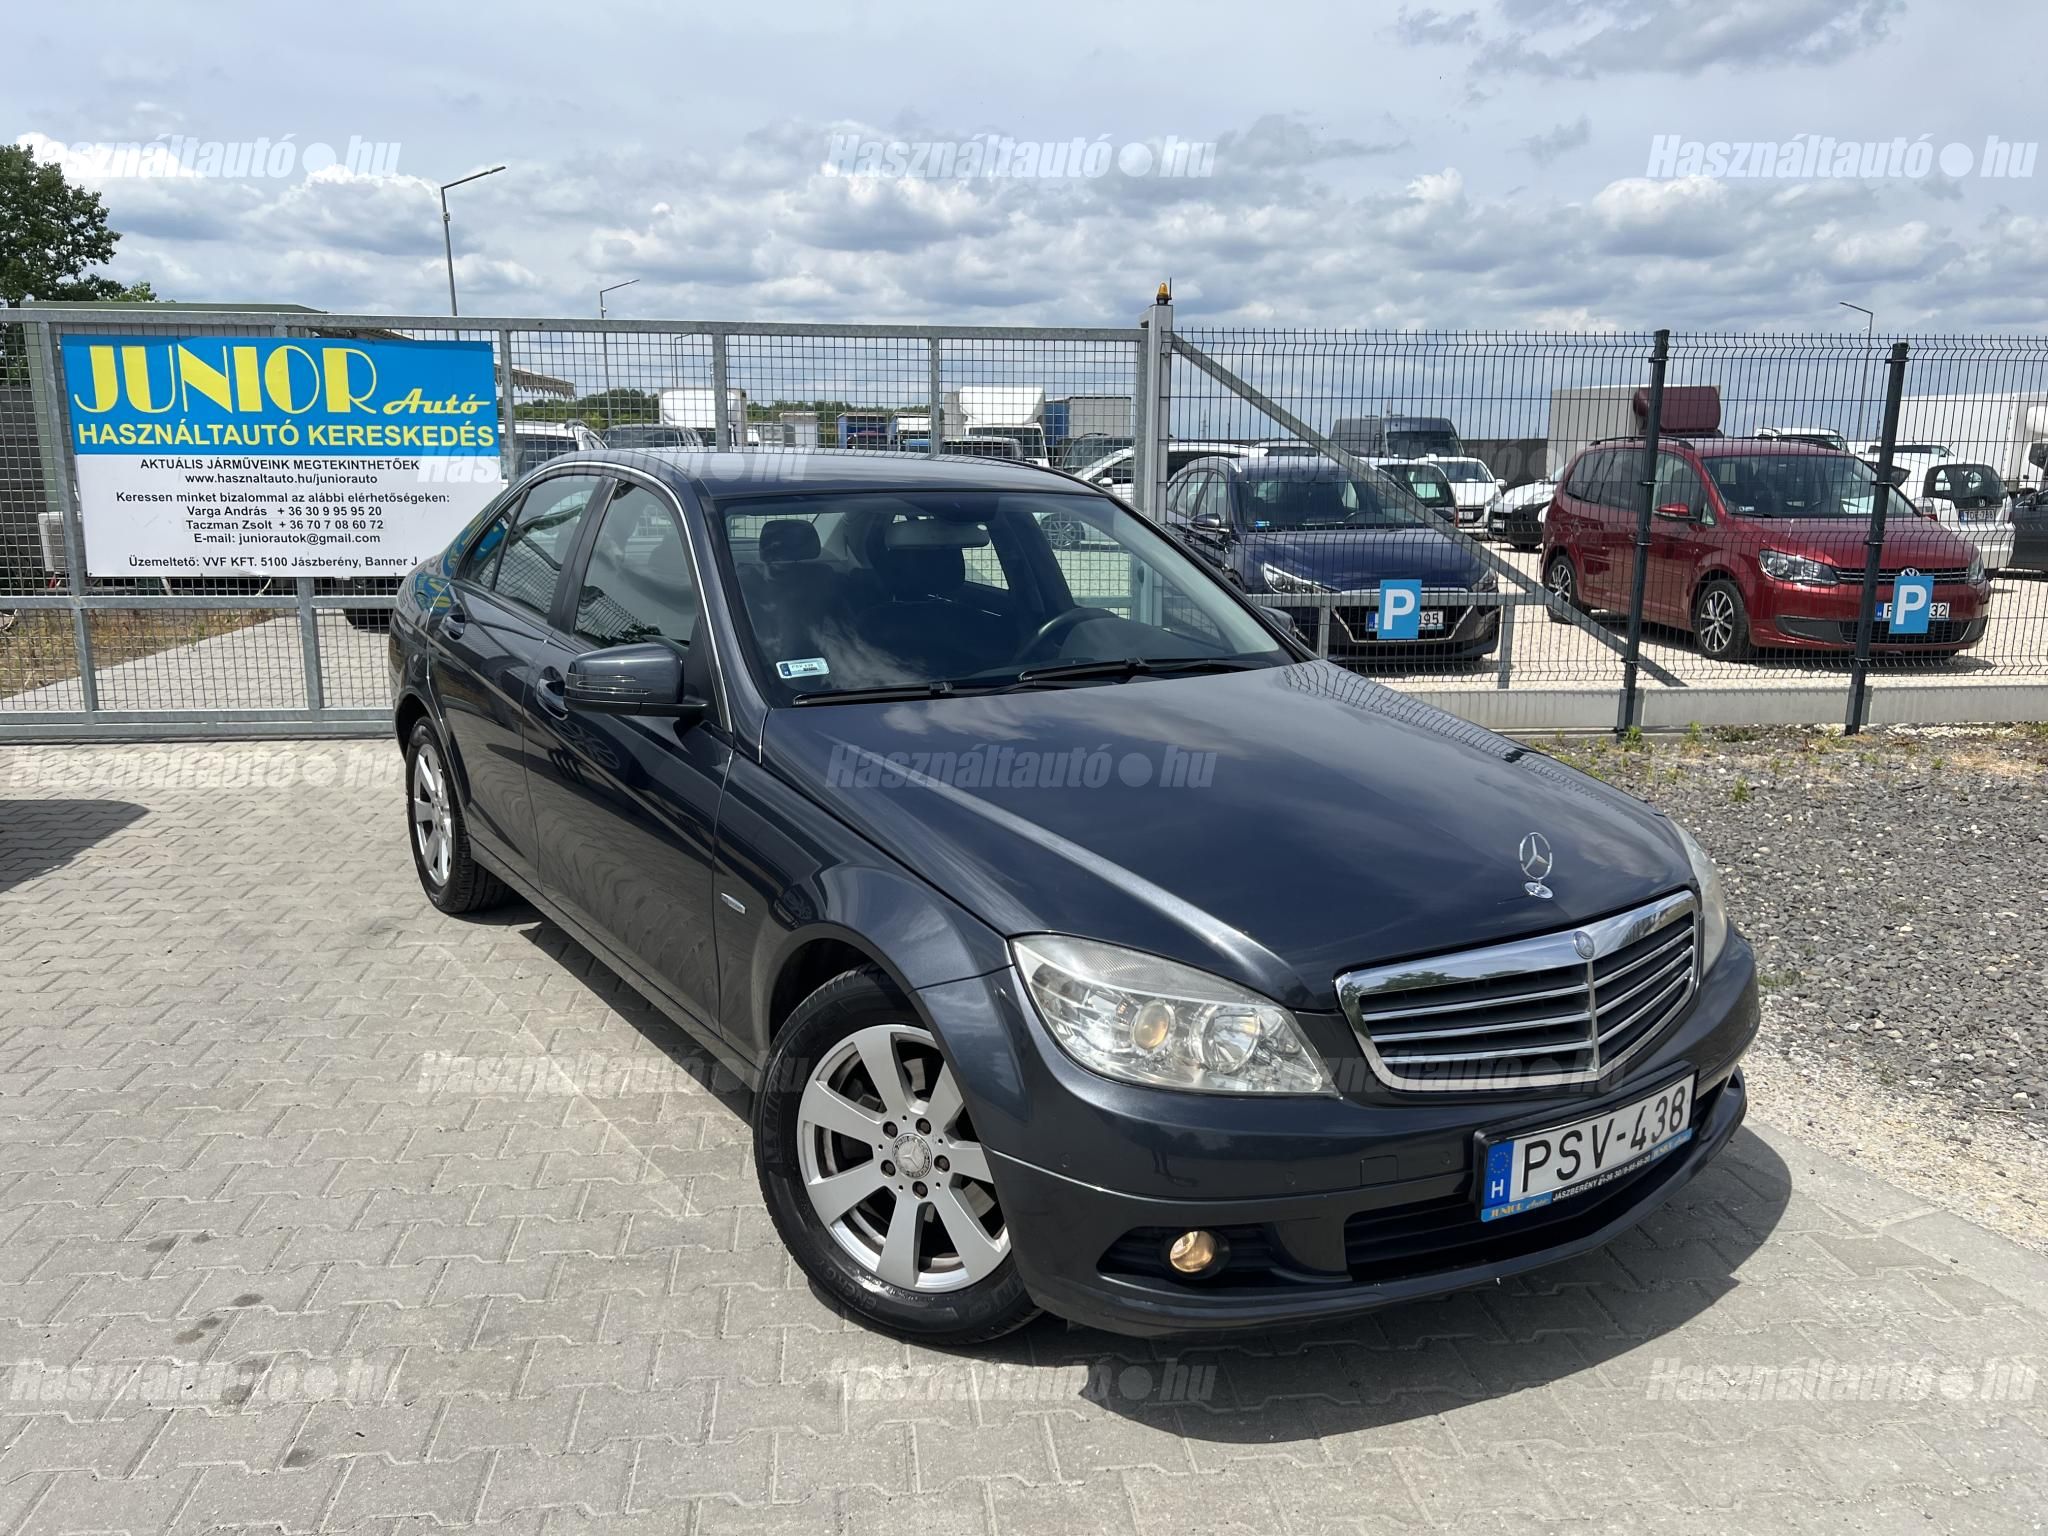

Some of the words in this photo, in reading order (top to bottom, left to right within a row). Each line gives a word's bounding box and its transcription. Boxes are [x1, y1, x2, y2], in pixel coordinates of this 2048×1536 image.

[74, 344, 377, 414] JUNIOR
[383, 388, 490, 415] Autó
[78, 419, 299, 446] HASZNÁLTAUTÓ
[308, 421, 494, 447] KERESKEDÉS
[140, 457, 203, 469] AKTUÁLIS
[207, 457, 290, 470] JÁRMŰVEINK
[293, 458, 420, 470] MEGTEKINTHETŐEK
[185, 473, 378, 485] www.hasznaltauto.hu/juniorauto
[116, 492, 172, 502] Keressen
[176, 492, 216, 502] minket
[220, 492, 288, 503] bizalommal
[308, 493, 344, 503] alábbi
[348, 493, 450, 504] elérhetőségeken:
[187, 506, 221, 518] Varga
[224, 505, 267, 516] András
[288, 506, 302, 516] 36
[305, 506, 319, 516] 30
[323, 506, 330, 516] 9
[333, 506, 348, 516] 95
[350, 506, 365, 516] 95
[368, 506, 382, 516] 20
[186, 520, 239, 530] Taczman
[242, 520, 273, 530] Zsolt
[290, 520, 304, 530] 36
[307, 520, 321, 530] 70
[324, 520, 331, 530] 7
[334, 520, 349, 530] 08
[352, 520, 366, 530] 60
[370, 520, 384, 530] 72
[194, 533, 235, 543] E-mail:
[238, 533, 380, 545] juniorautok@gmail.com
[129, 554, 200, 567] Üzemeltető:
[203, 557, 227, 567] VVF
[230, 557, 257, 567] KFT.
[260, 557, 288, 567] 5100
[291, 556, 362, 568] Jászberény,
[365, 556, 407, 567] Banner
[1383, 589, 1415, 630] P
[1895, 584, 1927, 625] P
[1491, 1179, 1504, 1199] H
[1521, 1085, 1686, 1194] PSV-438
